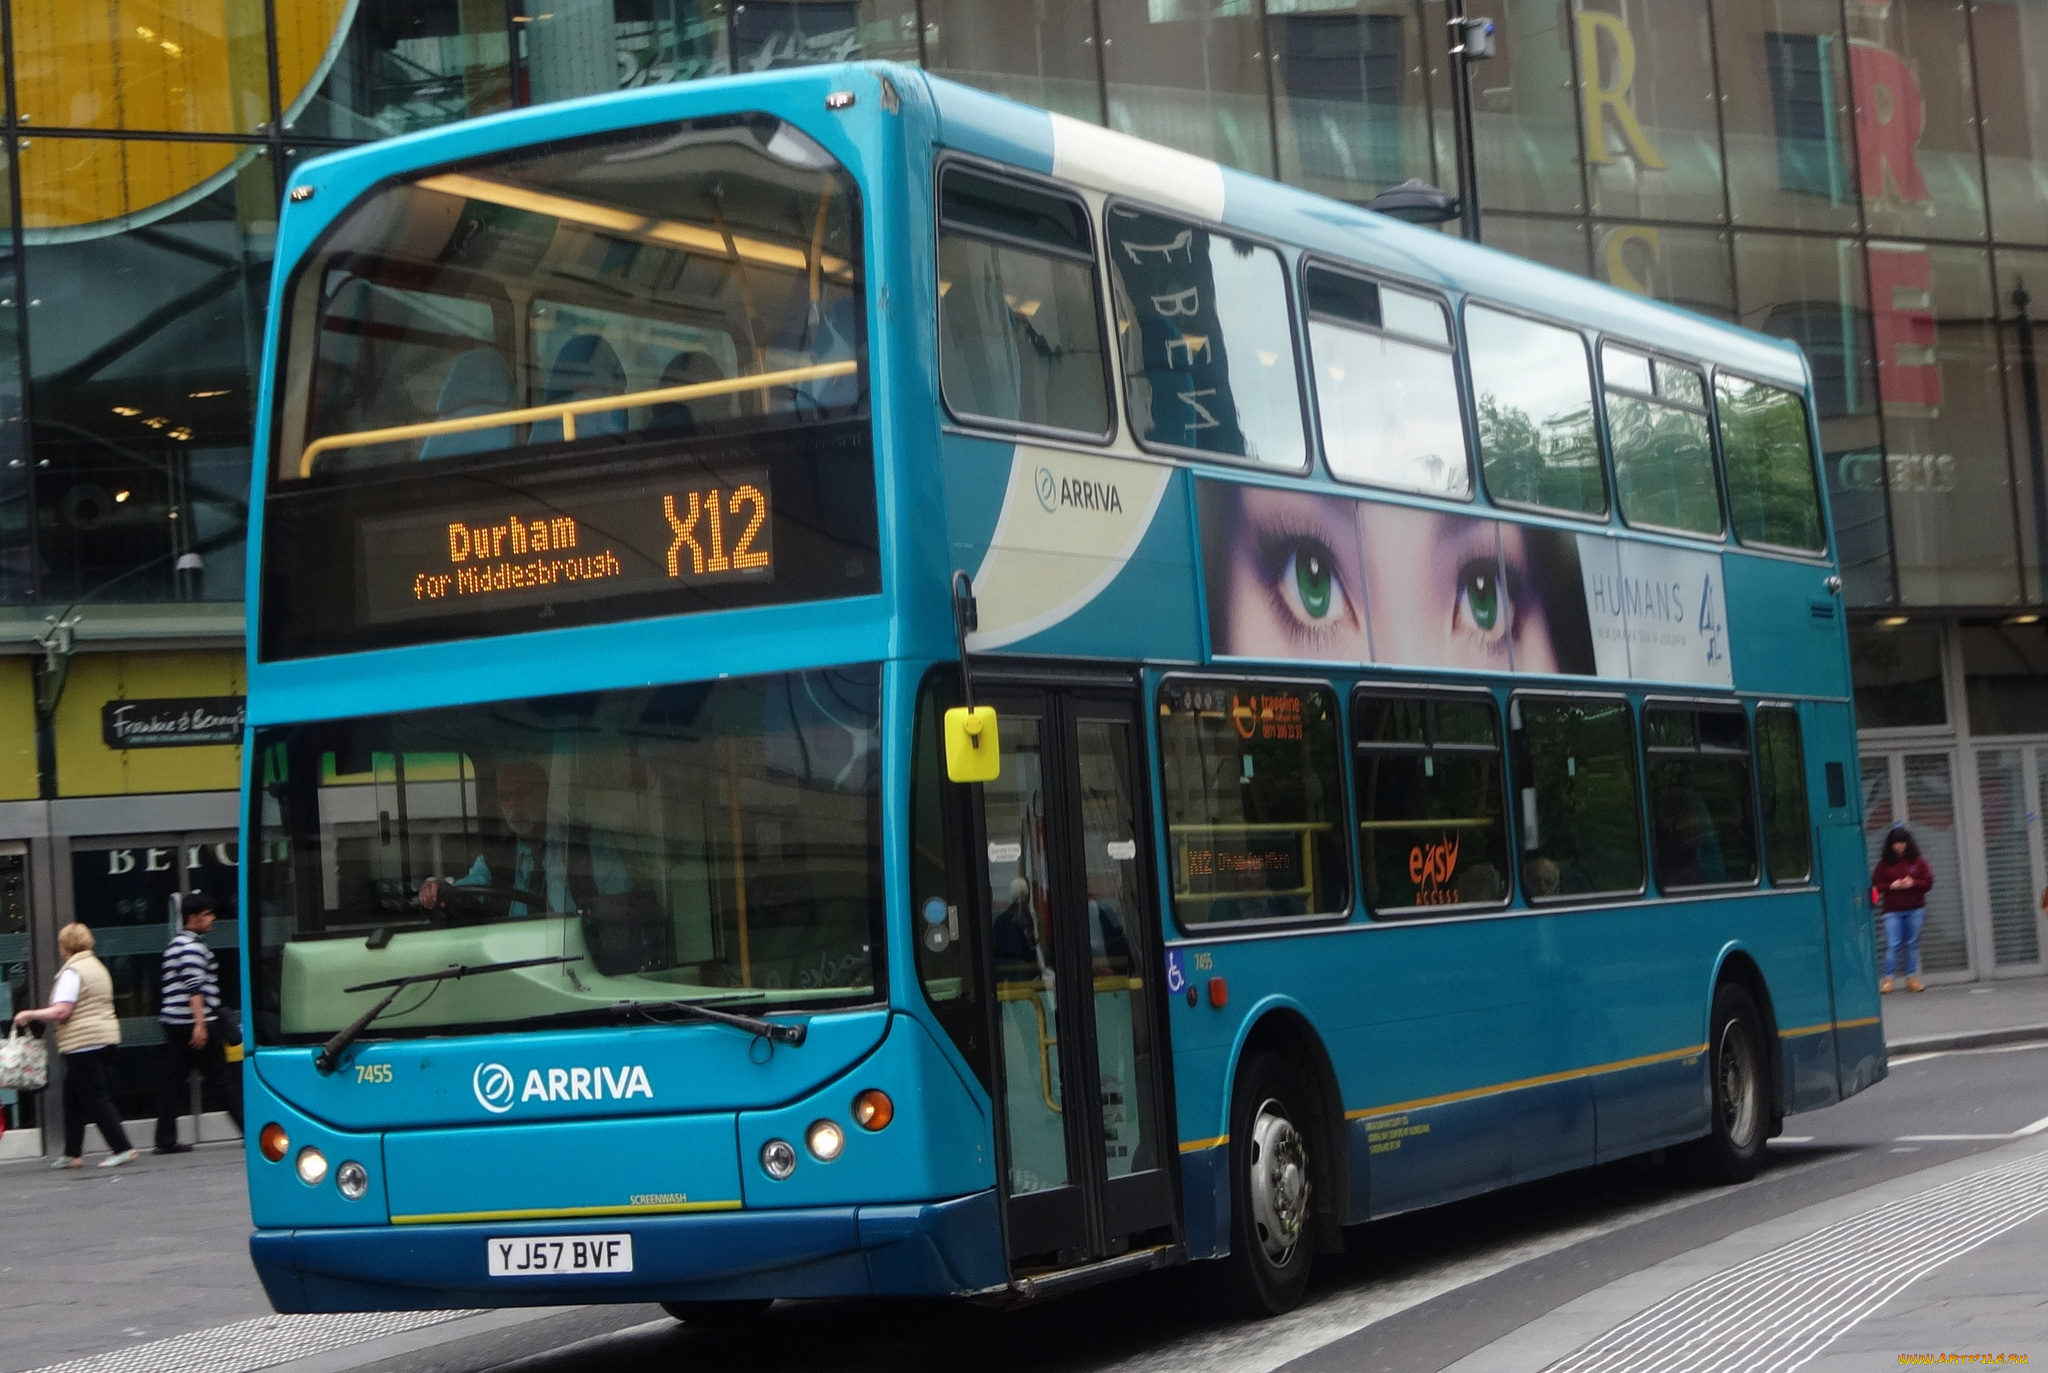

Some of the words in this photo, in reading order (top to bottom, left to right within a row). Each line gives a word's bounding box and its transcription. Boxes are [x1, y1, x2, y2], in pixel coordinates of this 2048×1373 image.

[1060, 476, 1123, 515] ARRIVA
[448, 515, 577, 563] Durham
[662, 485, 769, 578] X12
[414, 572, 451, 600] for
[457, 550, 621, 595] Middlesbrough
[1592, 572, 1684, 624] HUMANS
[355, 1064, 393, 1085] 7455
[521, 1065, 654, 1102] ARRIVA
[629, 1193, 687, 1206] SCREENWASH
[499, 1242, 564, 1271] YJ57
[573, 1240, 622, 1269] BVF
